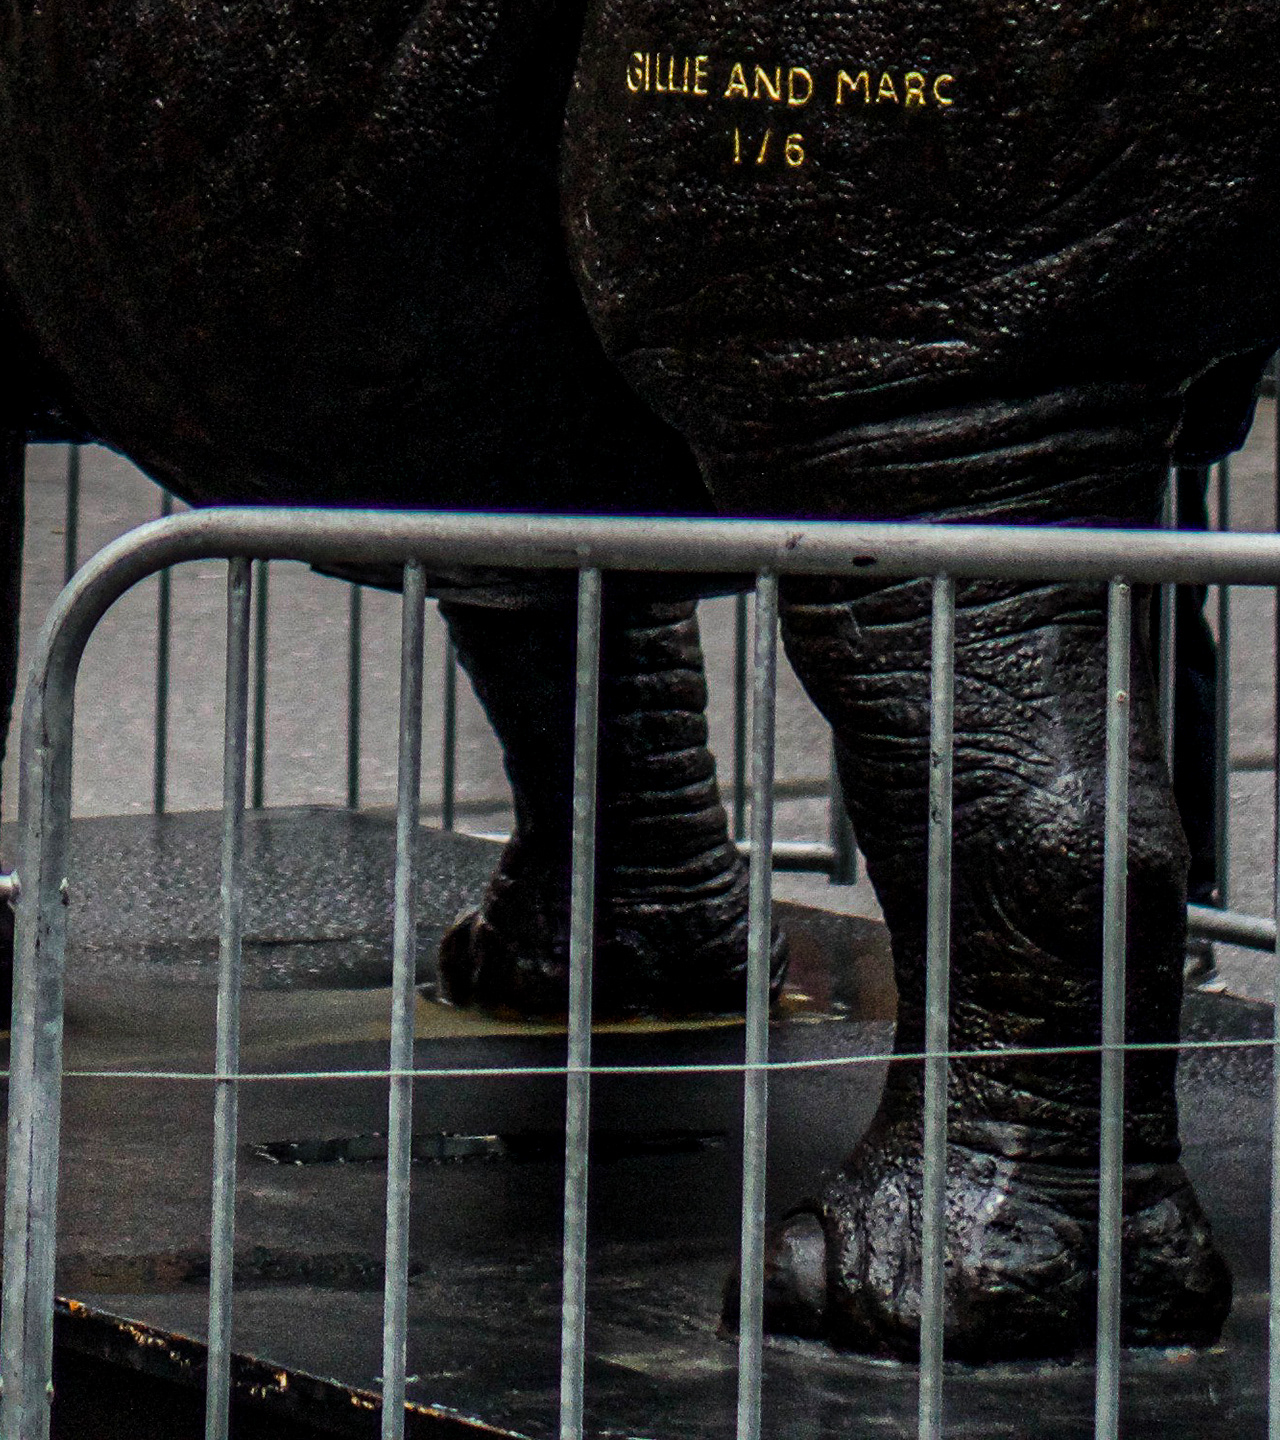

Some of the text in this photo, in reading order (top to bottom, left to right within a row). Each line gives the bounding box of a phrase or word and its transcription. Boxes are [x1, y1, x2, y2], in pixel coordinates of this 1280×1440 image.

[627, 52, 955, 106] GILLIE AND MARC
